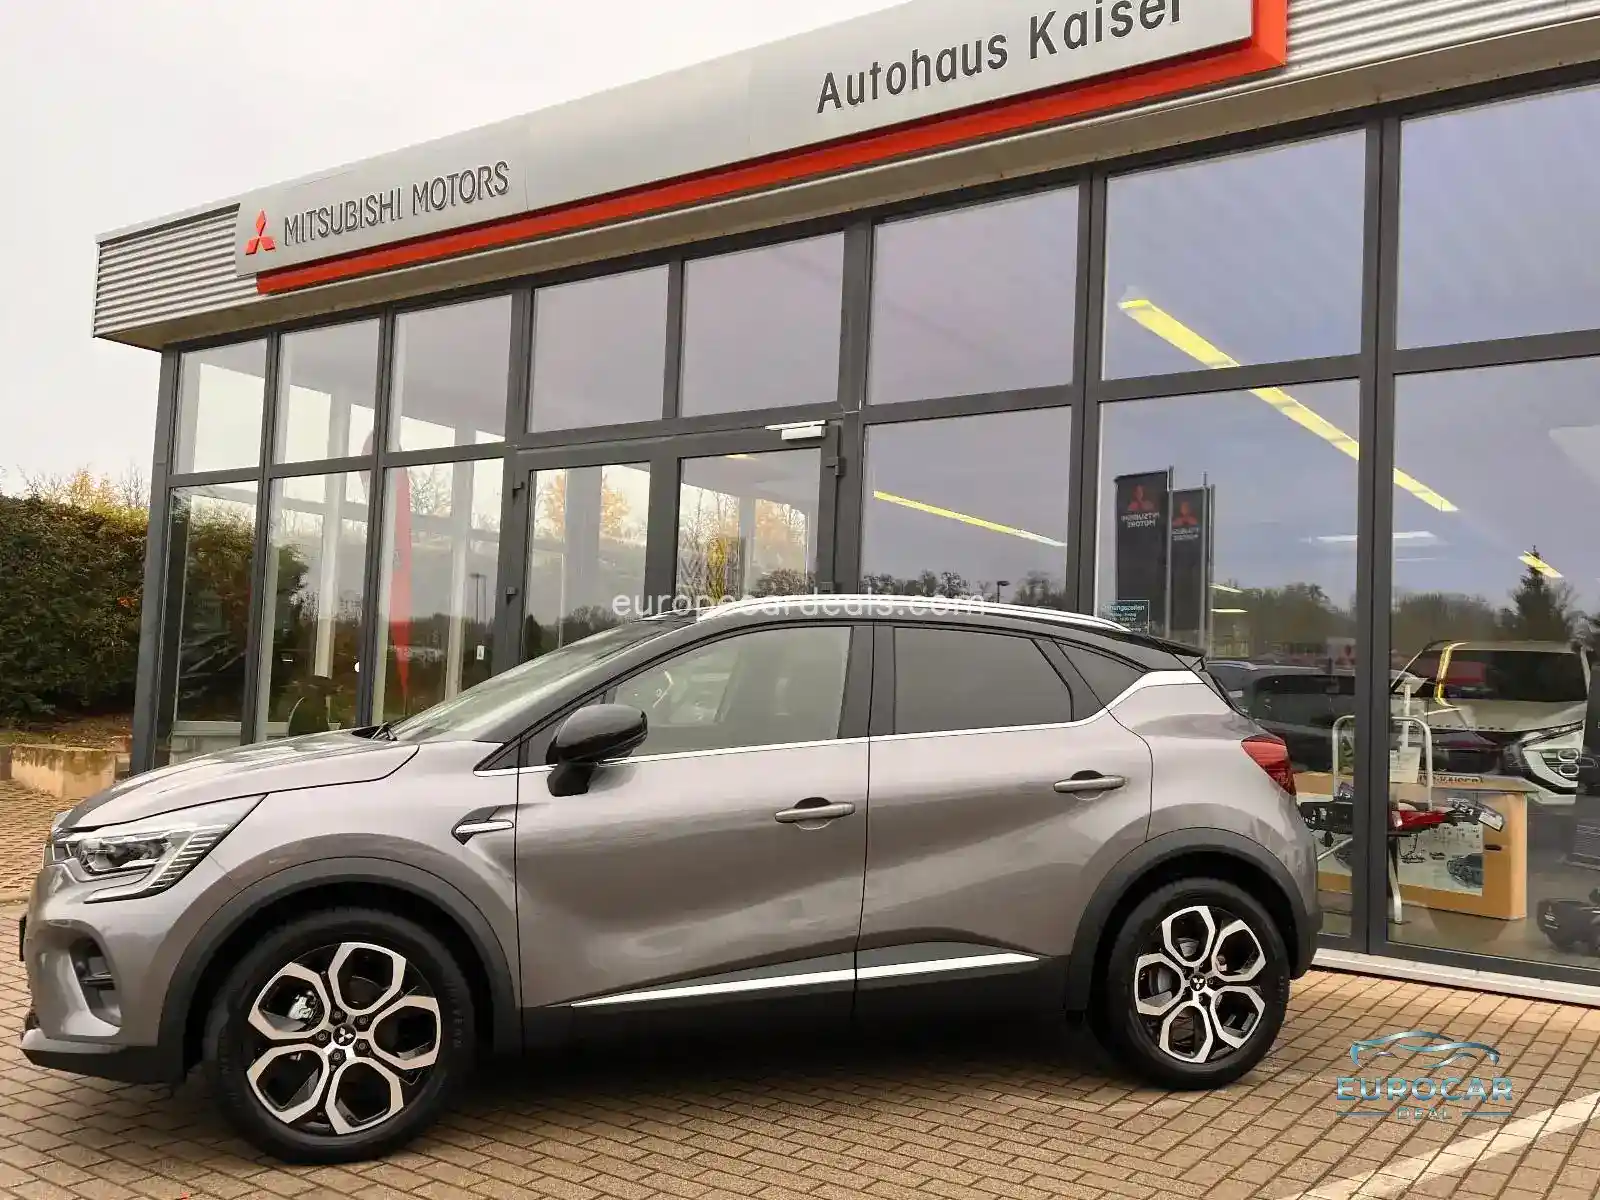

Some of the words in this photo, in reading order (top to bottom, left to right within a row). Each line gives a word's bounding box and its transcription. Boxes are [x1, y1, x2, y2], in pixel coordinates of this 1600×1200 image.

[817, 33, 1008, 114] Autohaus
[284, 187, 403, 247] MITSUBISHI
[412, 160, 510, 216] MOTORS
